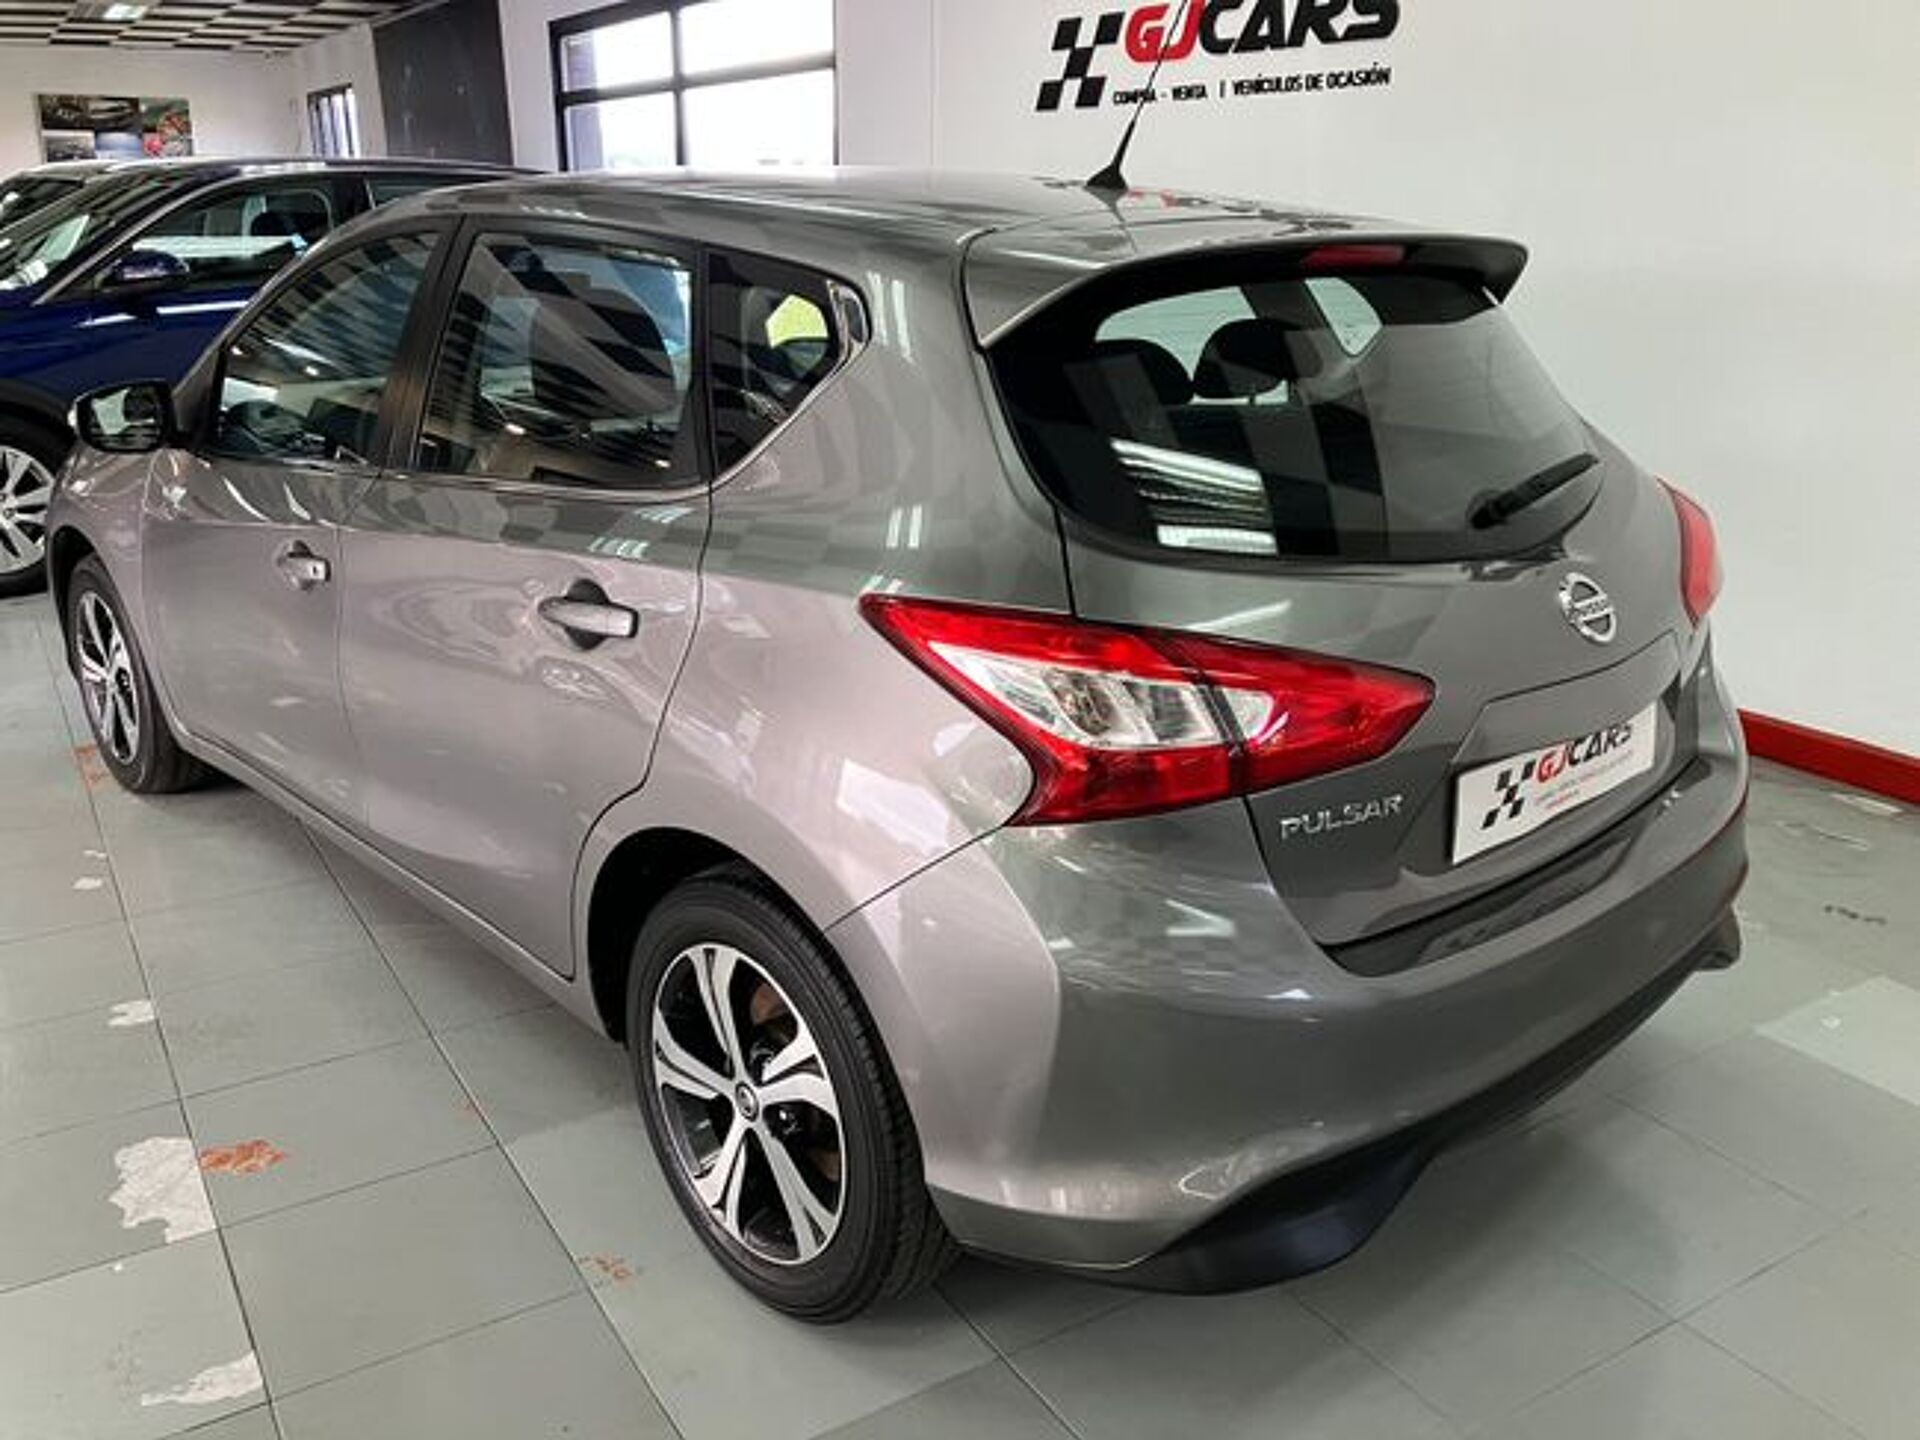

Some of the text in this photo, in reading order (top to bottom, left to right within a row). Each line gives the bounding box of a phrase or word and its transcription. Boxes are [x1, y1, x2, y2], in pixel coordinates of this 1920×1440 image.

[1125, 0, 1399, 62] GJCARS
[1305, 73, 1323, 91] DE
[1280, 794, 1403, 840] PULSAR
